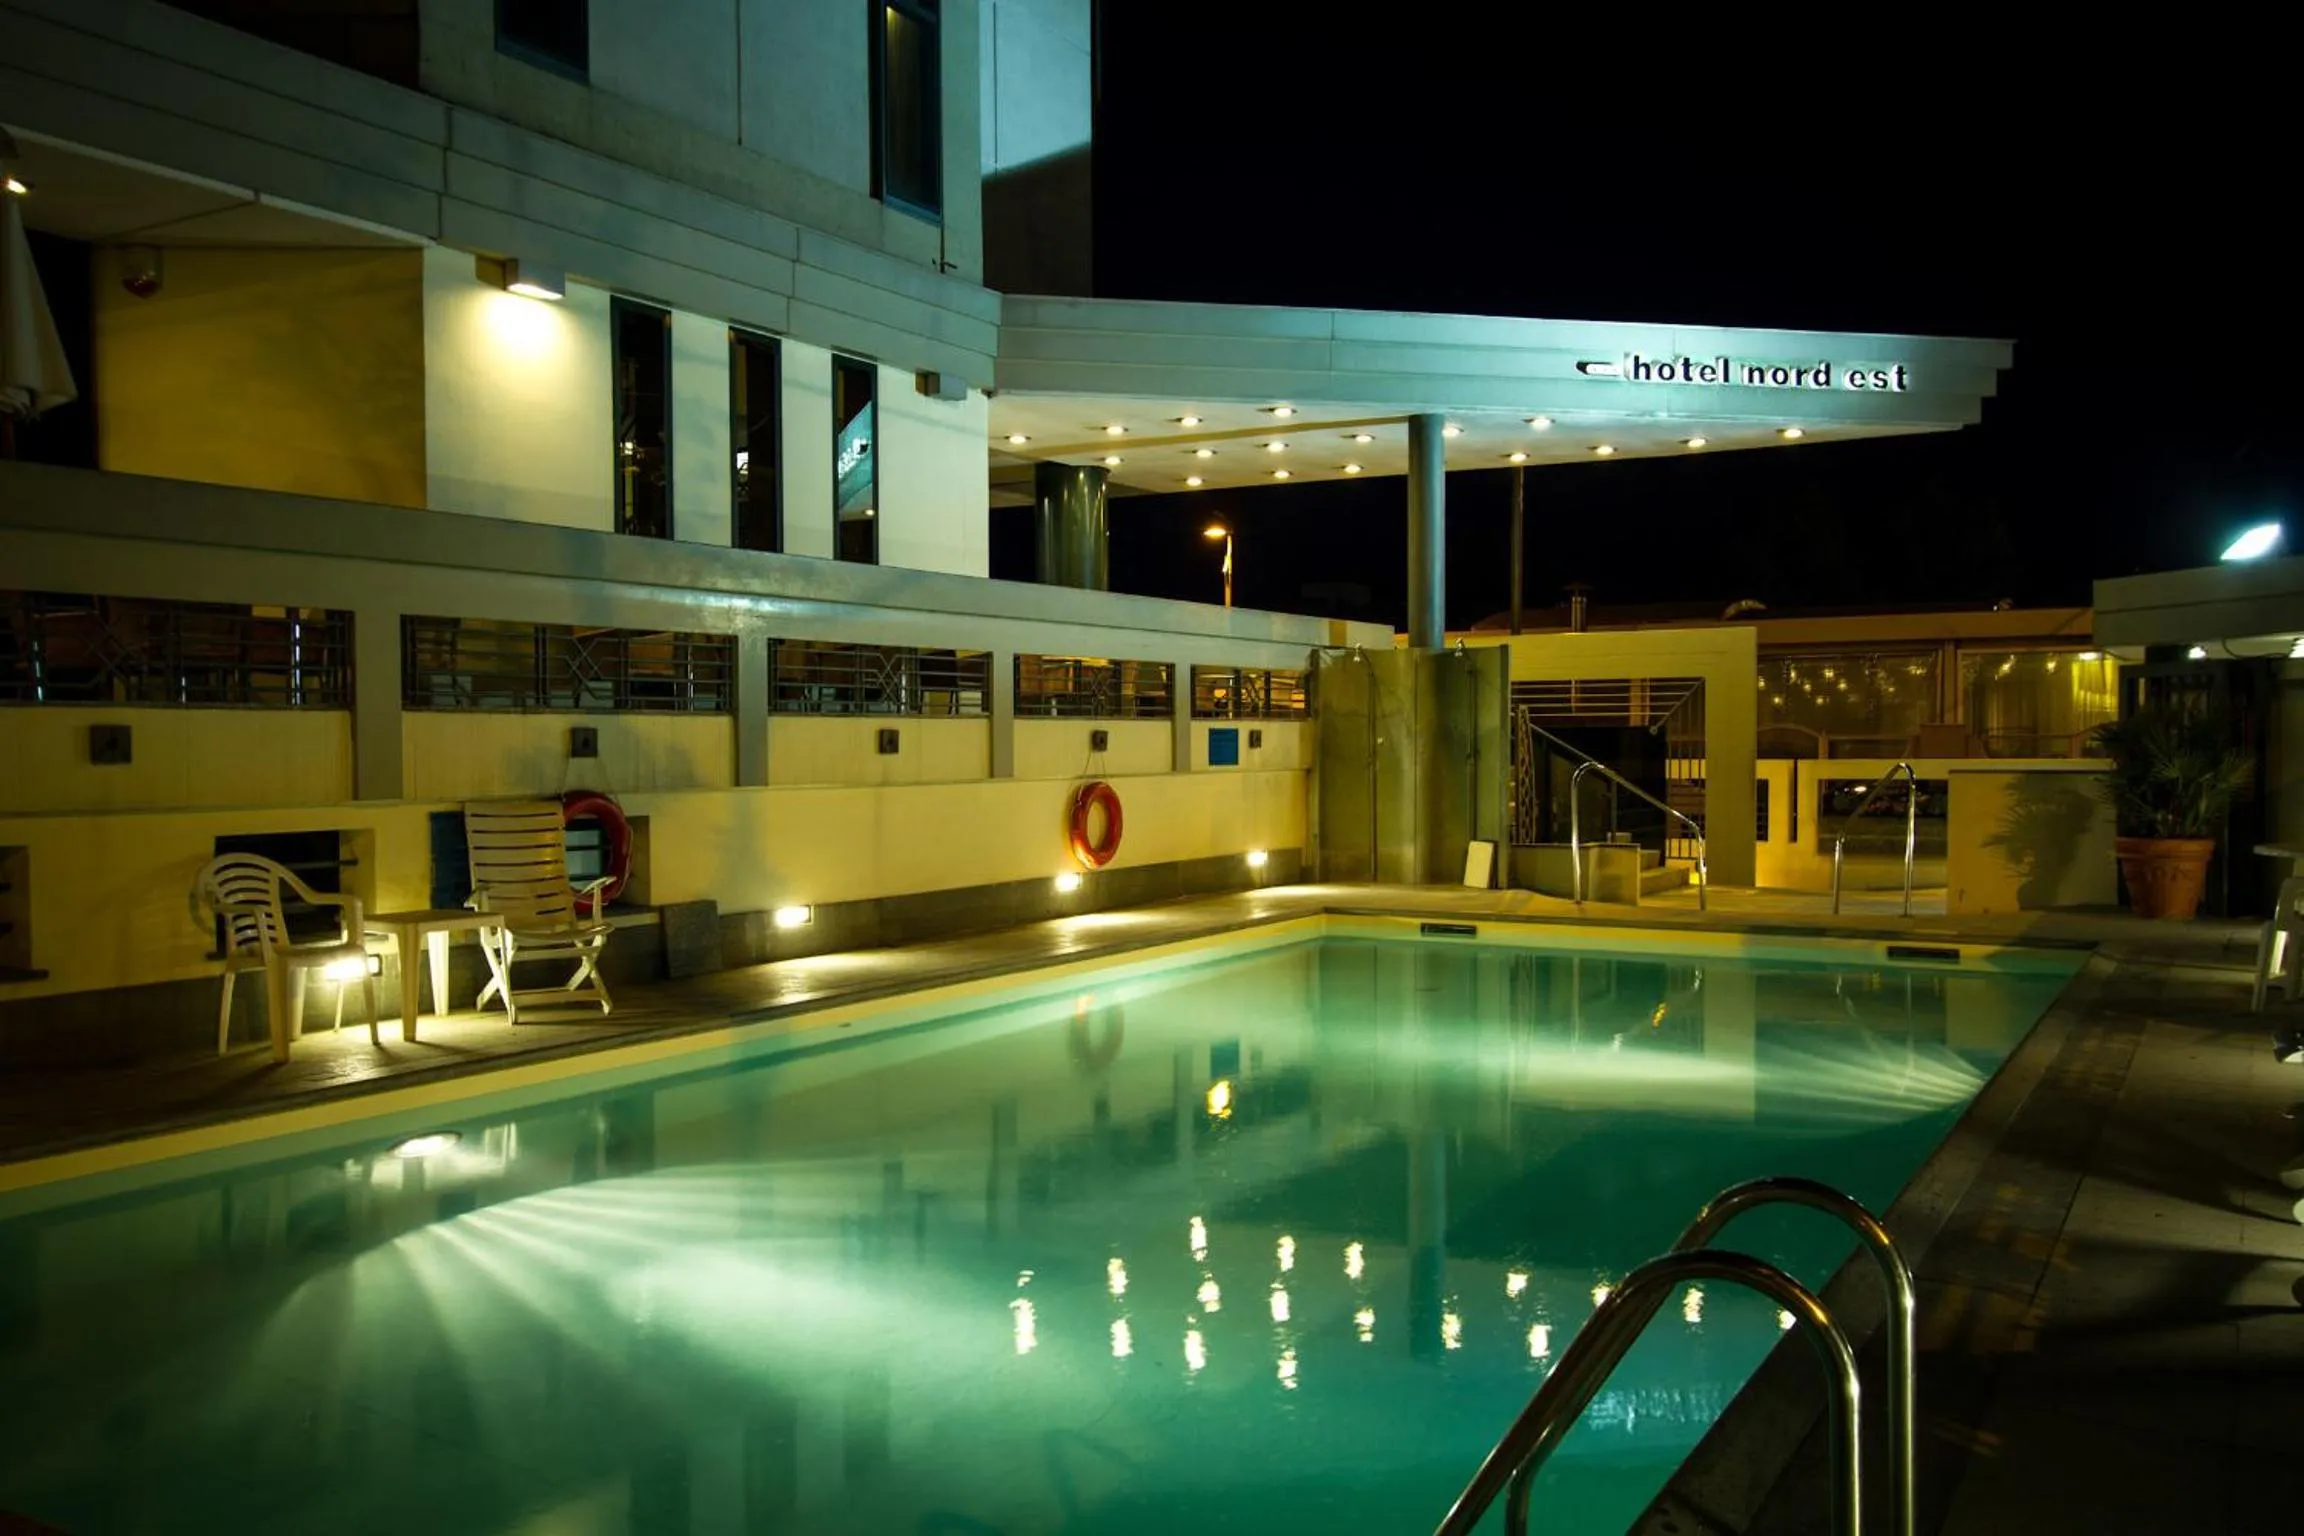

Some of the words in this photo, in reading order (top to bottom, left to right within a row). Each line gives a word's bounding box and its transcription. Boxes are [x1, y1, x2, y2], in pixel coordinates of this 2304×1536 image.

[1632, 354, 1730, 383] hotel
[1747, 361, 1831, 387] nord
[1849, 364, 1907, 391] est
